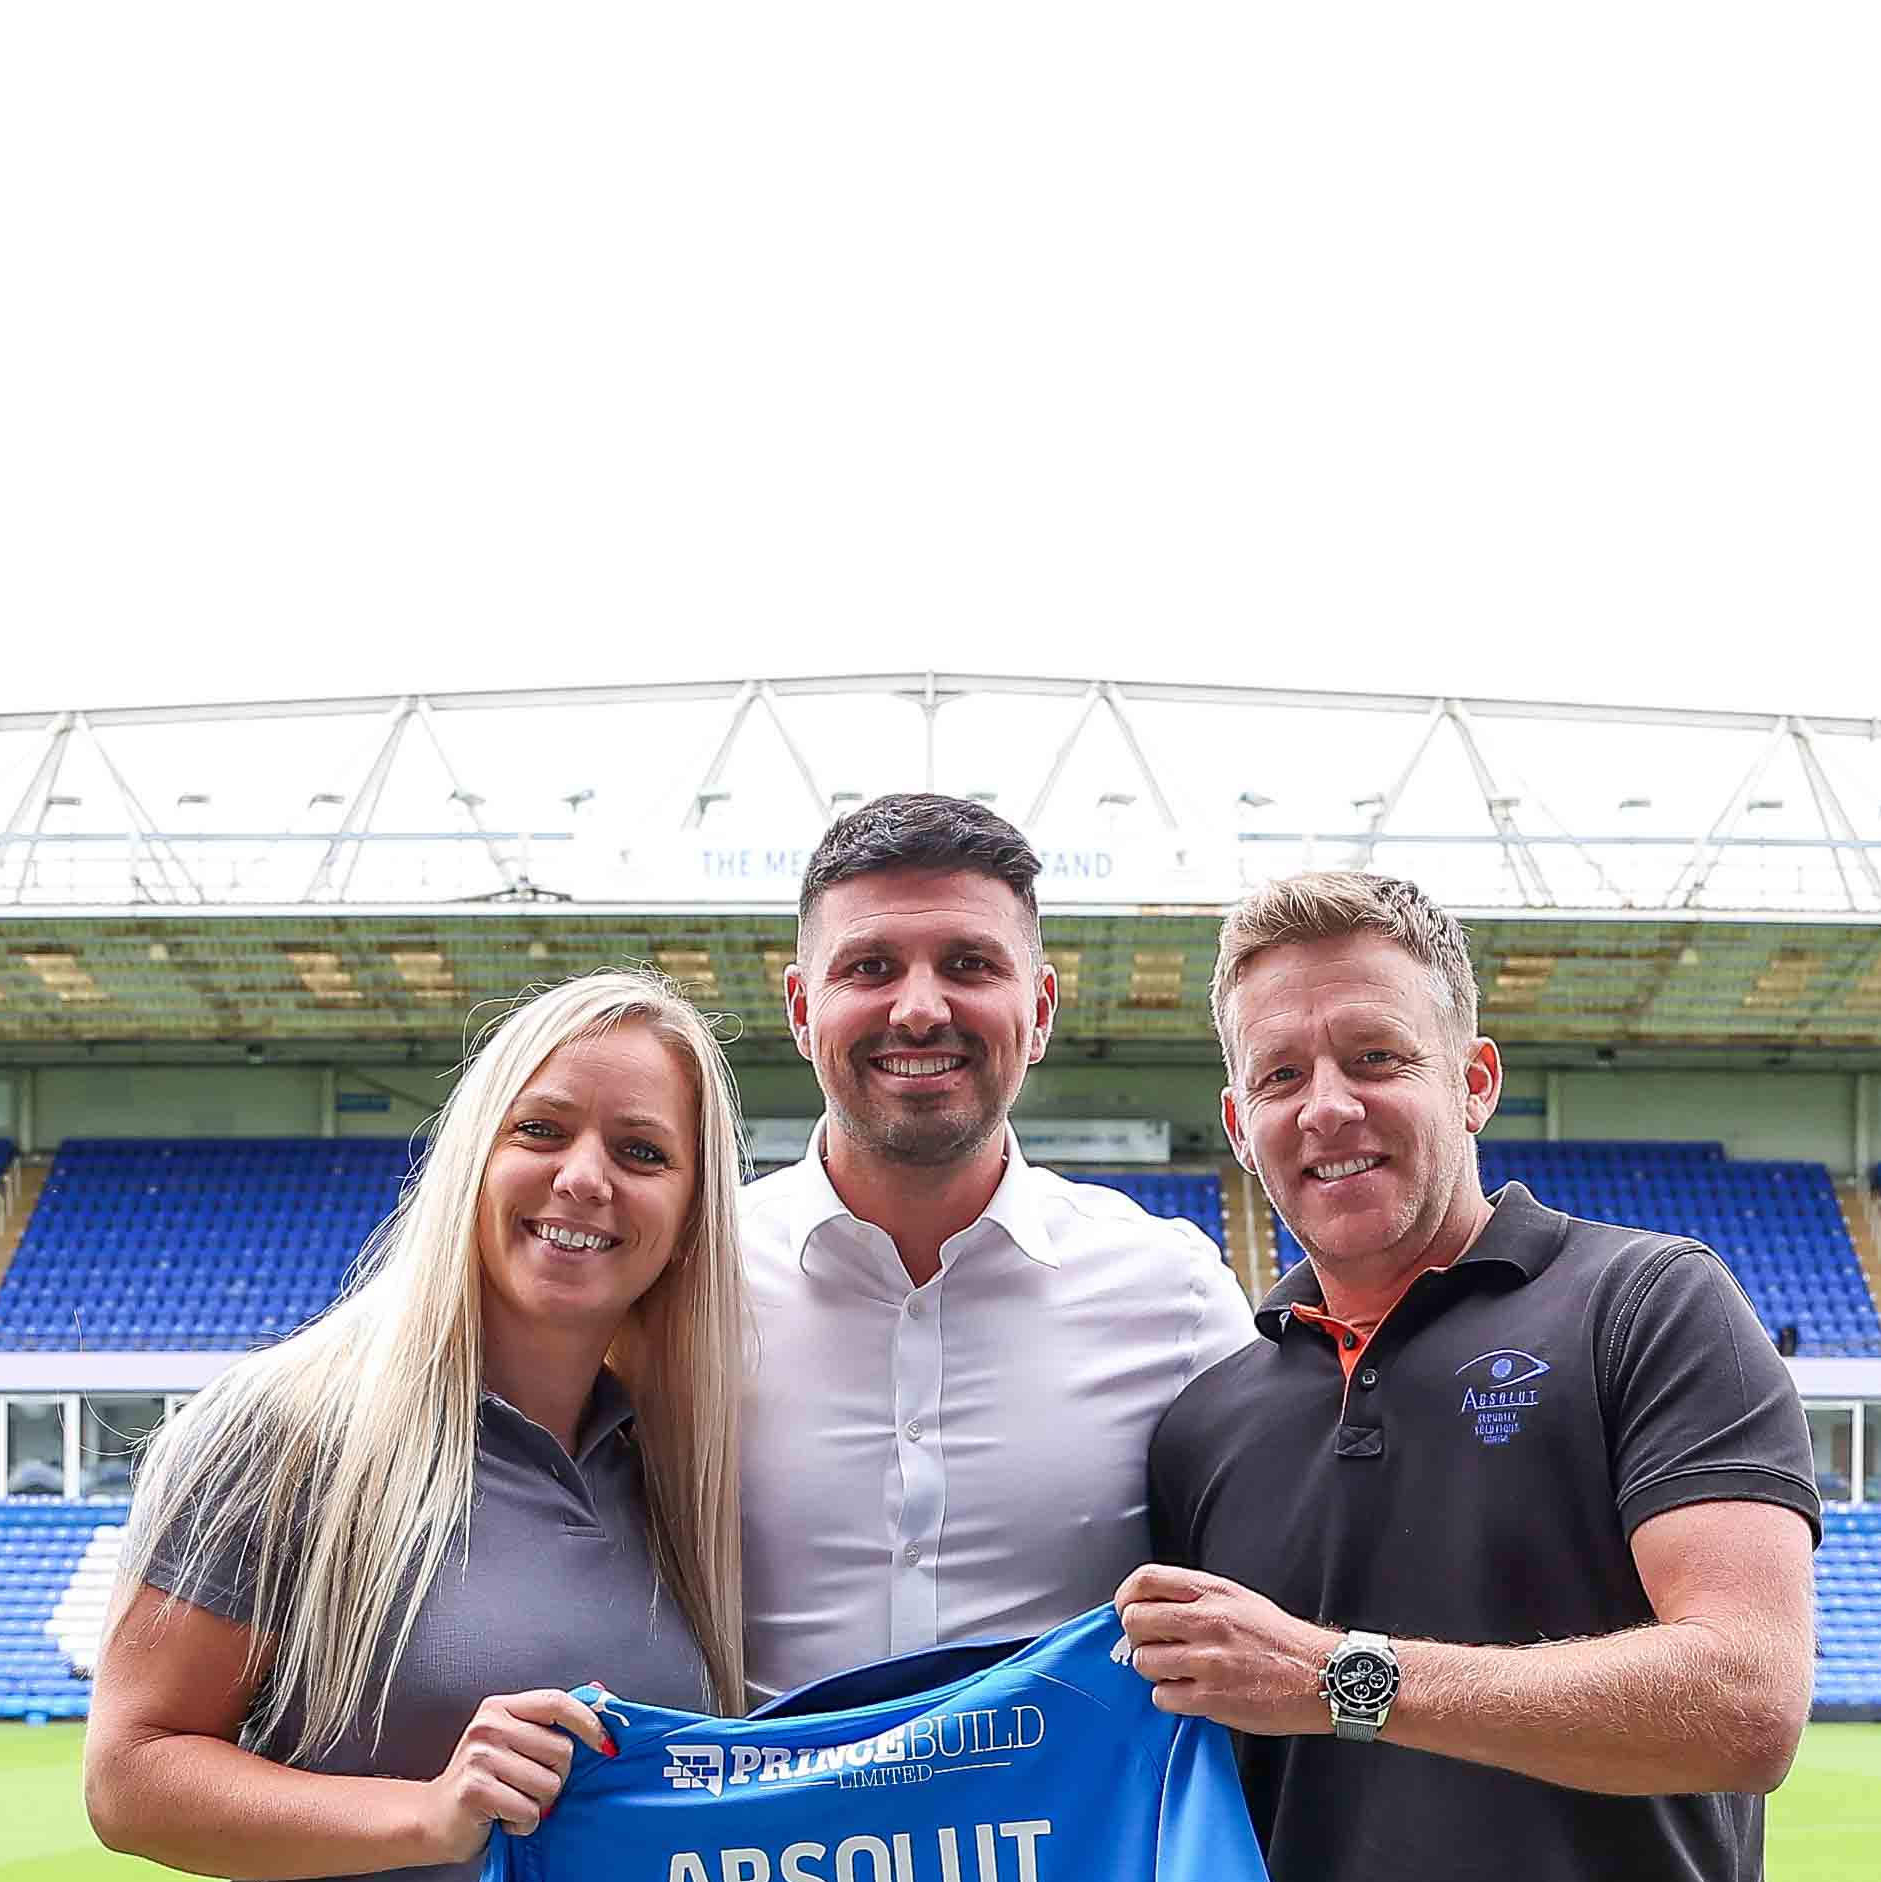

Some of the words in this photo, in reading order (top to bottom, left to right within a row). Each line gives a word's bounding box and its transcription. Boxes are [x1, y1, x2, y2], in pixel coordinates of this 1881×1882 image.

[701, 851, 751, 878] THE
[1039, 851, 1114, 879] TAND
[728, 1704, 1046, 1786] PRINCEBUILD
[836, 1762, 934, 1790] LIMITED
